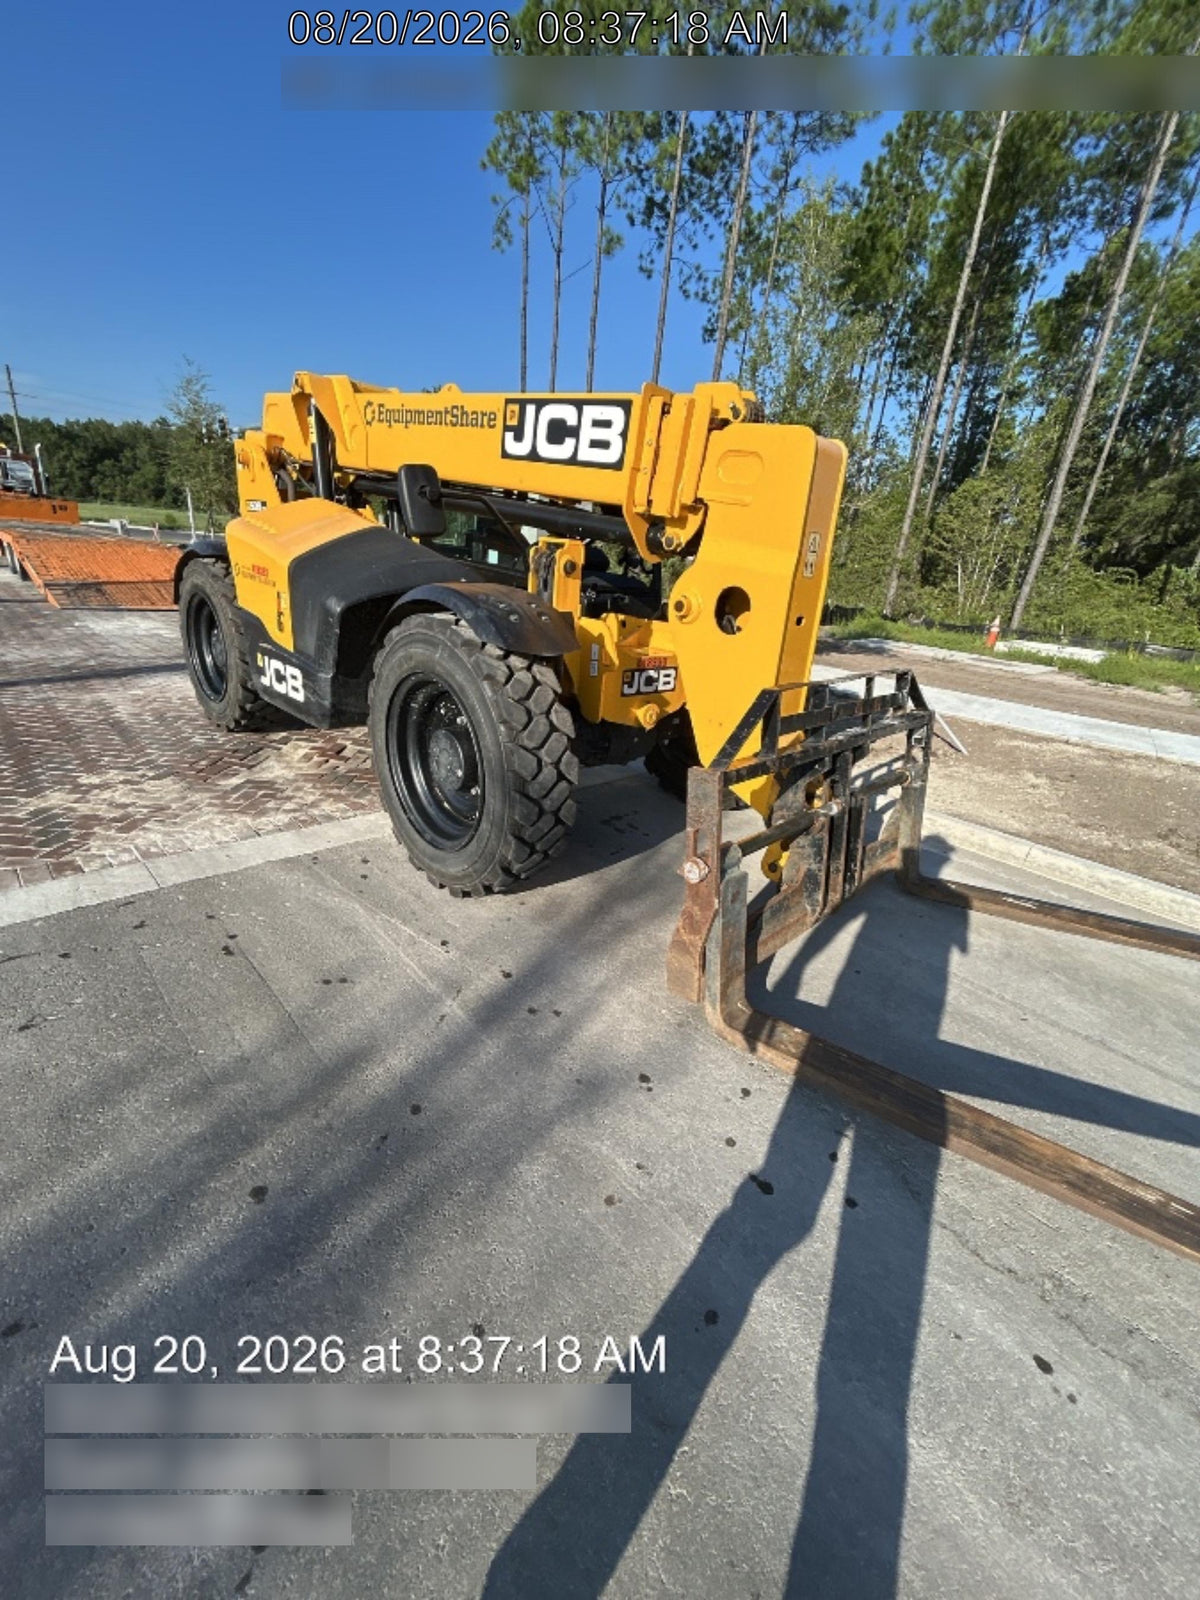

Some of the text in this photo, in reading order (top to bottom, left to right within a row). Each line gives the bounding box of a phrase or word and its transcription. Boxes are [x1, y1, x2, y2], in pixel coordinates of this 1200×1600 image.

[377, 403, 497, 429] EquipmentShare
[504, 403, 626, 464] JCB
[260, 655, 305, 703] JCB
[623, 668, 677, 695] JCB
